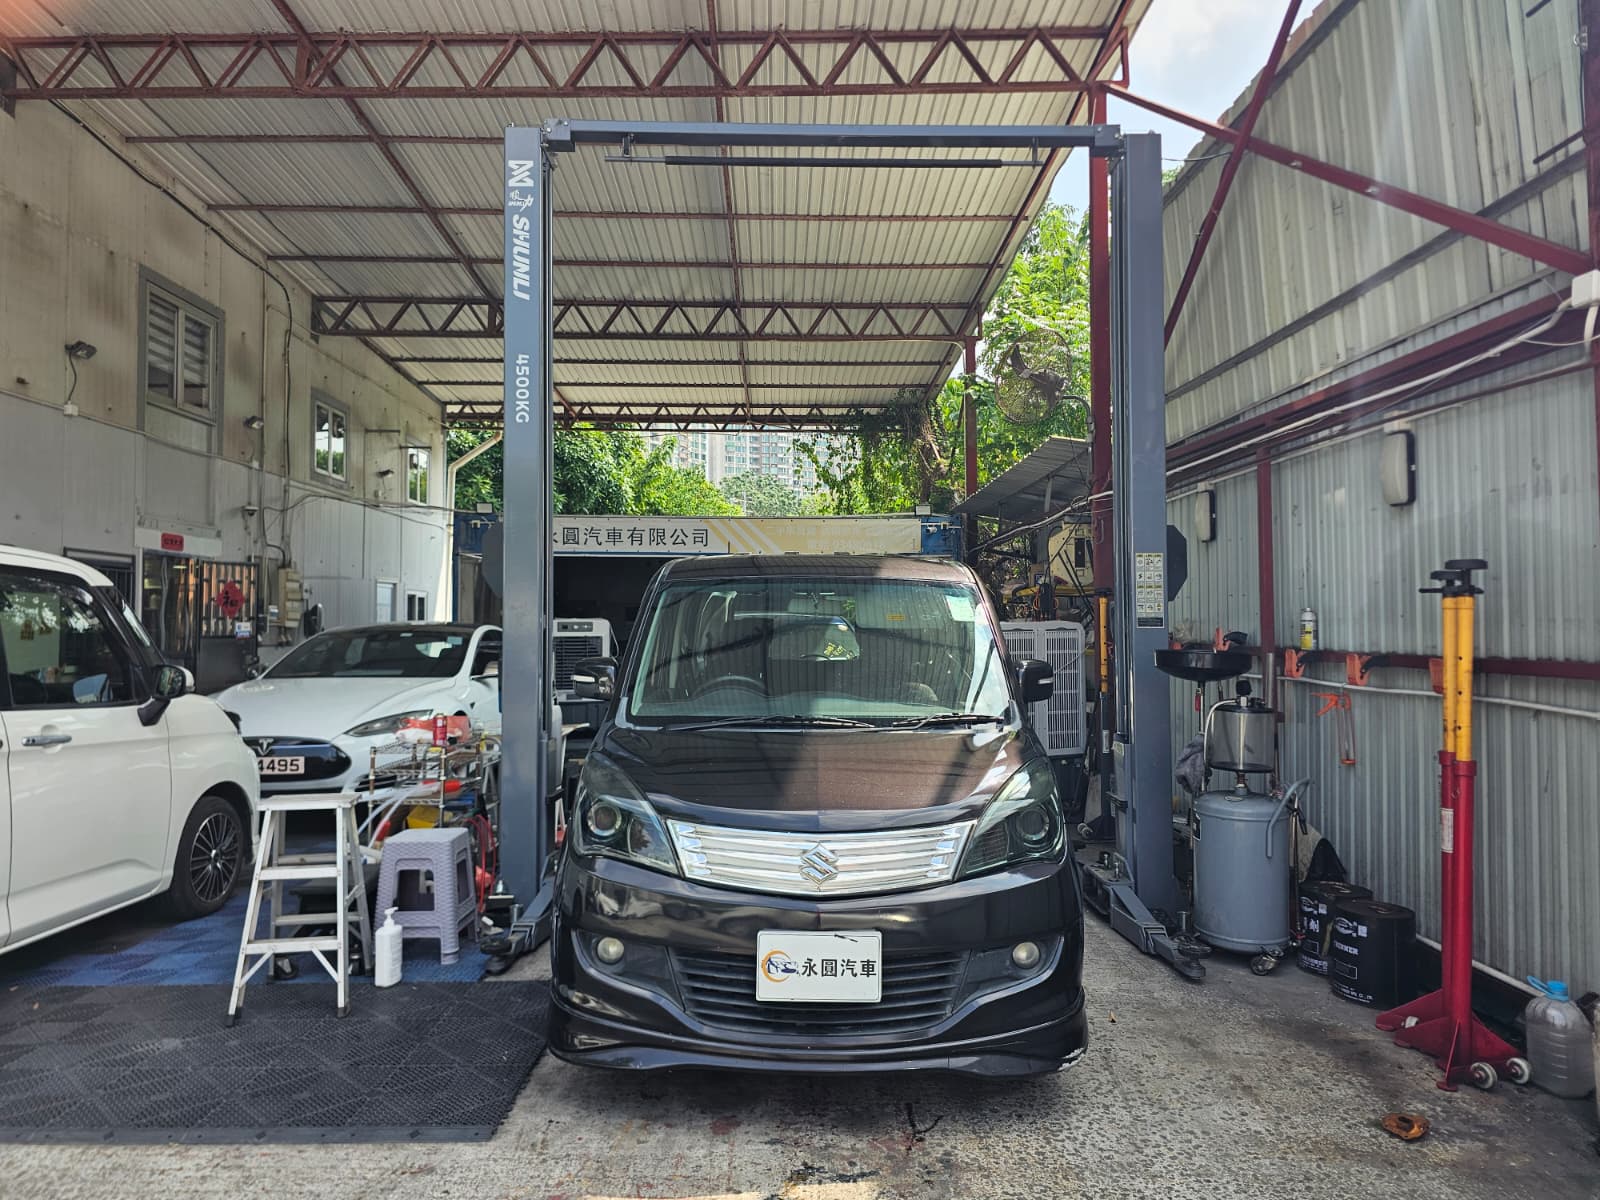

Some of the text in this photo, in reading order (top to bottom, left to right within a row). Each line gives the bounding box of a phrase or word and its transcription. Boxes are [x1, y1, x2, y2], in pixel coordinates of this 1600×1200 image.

[513, 214, 530, 300] SHUNLI
[515, 354, 529, 423] 4500KG
[801, 957, 877, 978] 永圓汽車
